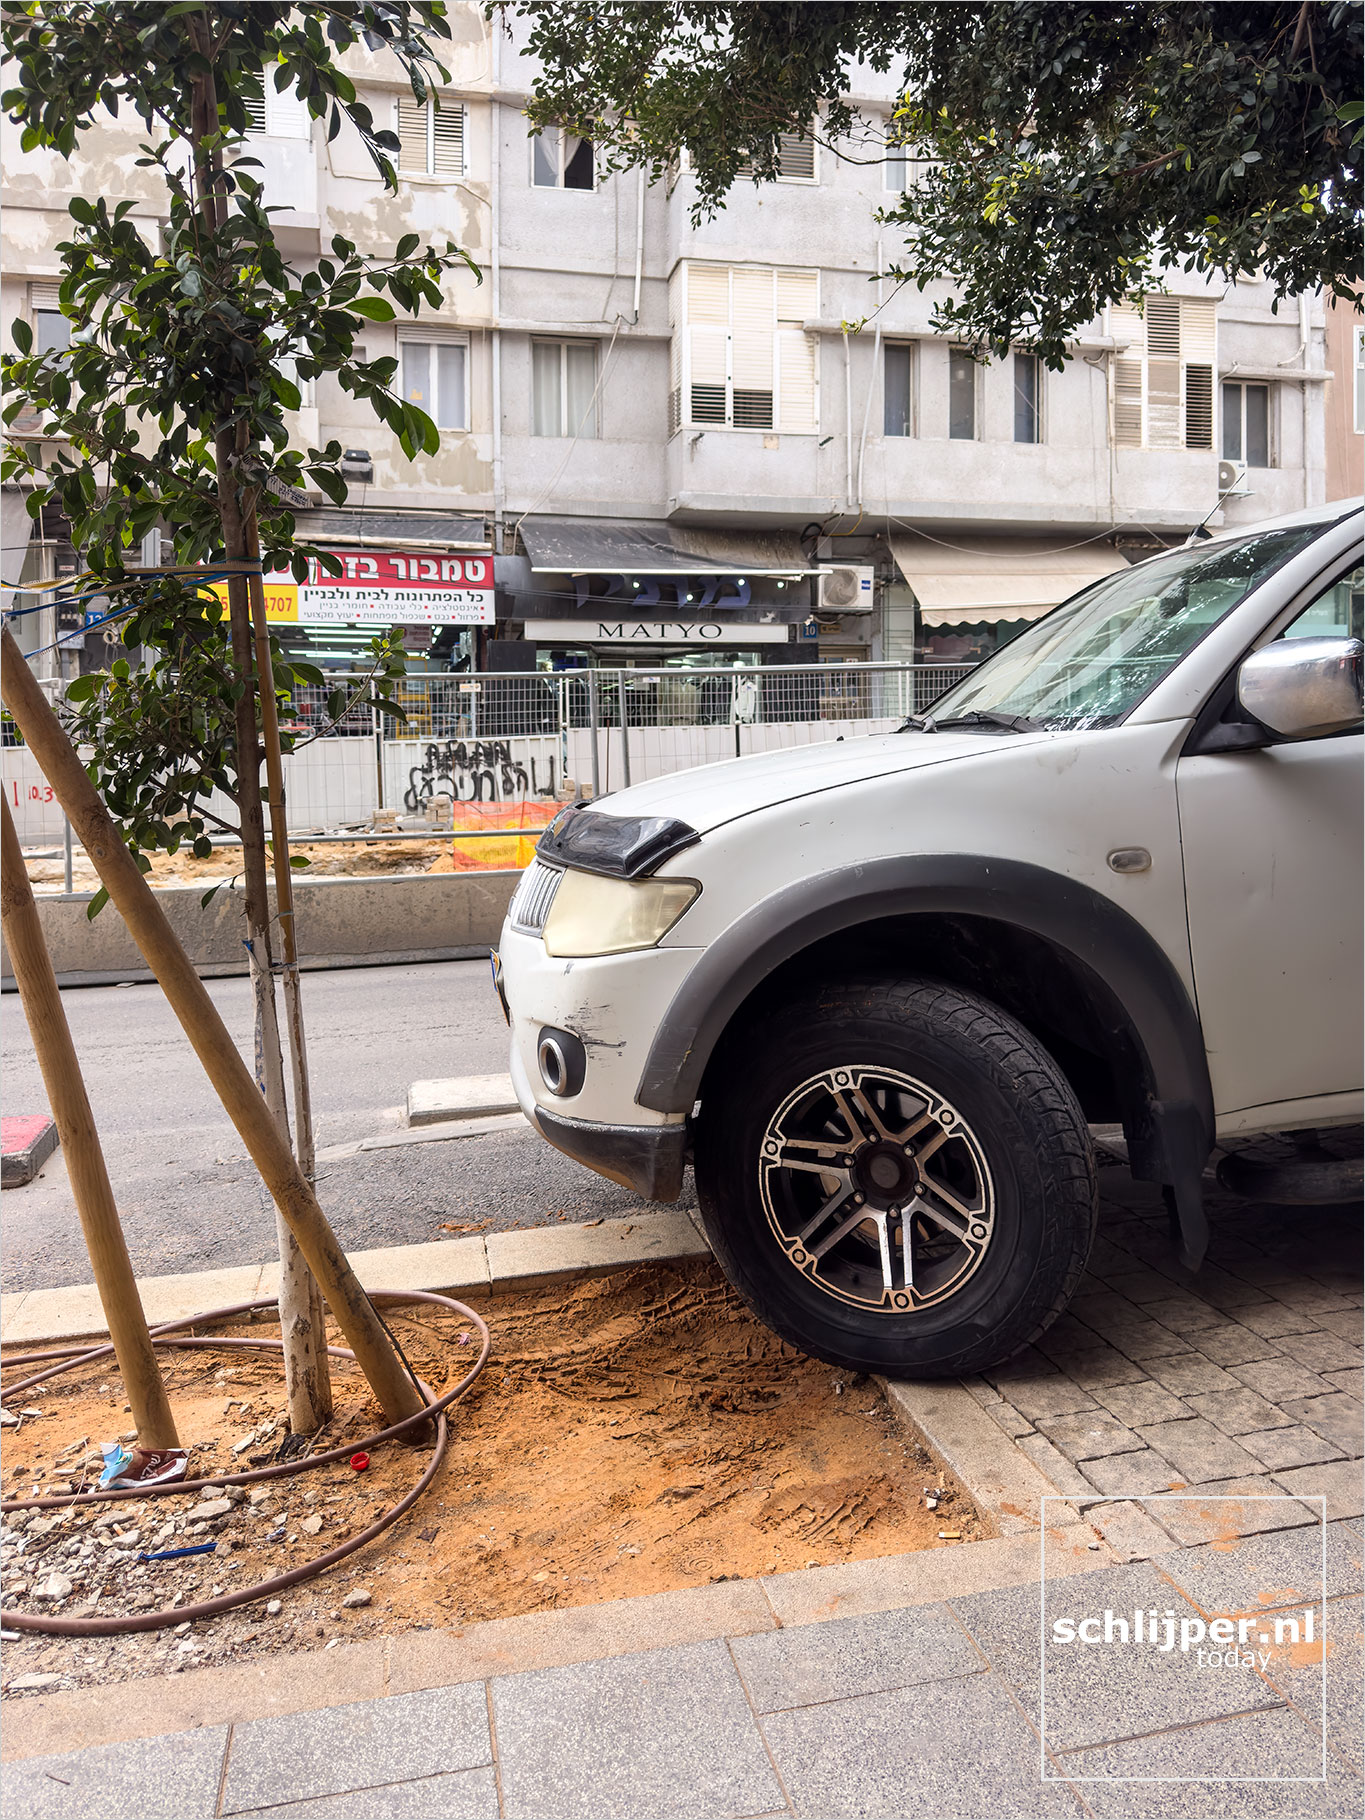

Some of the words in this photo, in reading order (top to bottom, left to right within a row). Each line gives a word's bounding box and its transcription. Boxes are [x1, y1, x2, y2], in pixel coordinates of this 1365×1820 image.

[389, 558, 486, 582] טמבור
[304, 588, 350, 601] ולבניין
[355, 588, 389, 601] לבית
[394, 591, 462, 602] הפתרונות
[466, 590, 484, 602] כל
[342, 602, 368, 610] חומרי
[379, 602, 406, 610] עבודה
[409, 602, 422, 610] כלי
[432, 602, 479, 611] אינסטלציה
[303, 611, 334, 620] מקצועי
[363, 612, 398, 620] מפתחות
[399, 611, 426, 620] שכפול
[457, 612, 479, 621] פרזול
[597, 622, 722, 639] MATYO
[805, 625, 816, 636] 10
